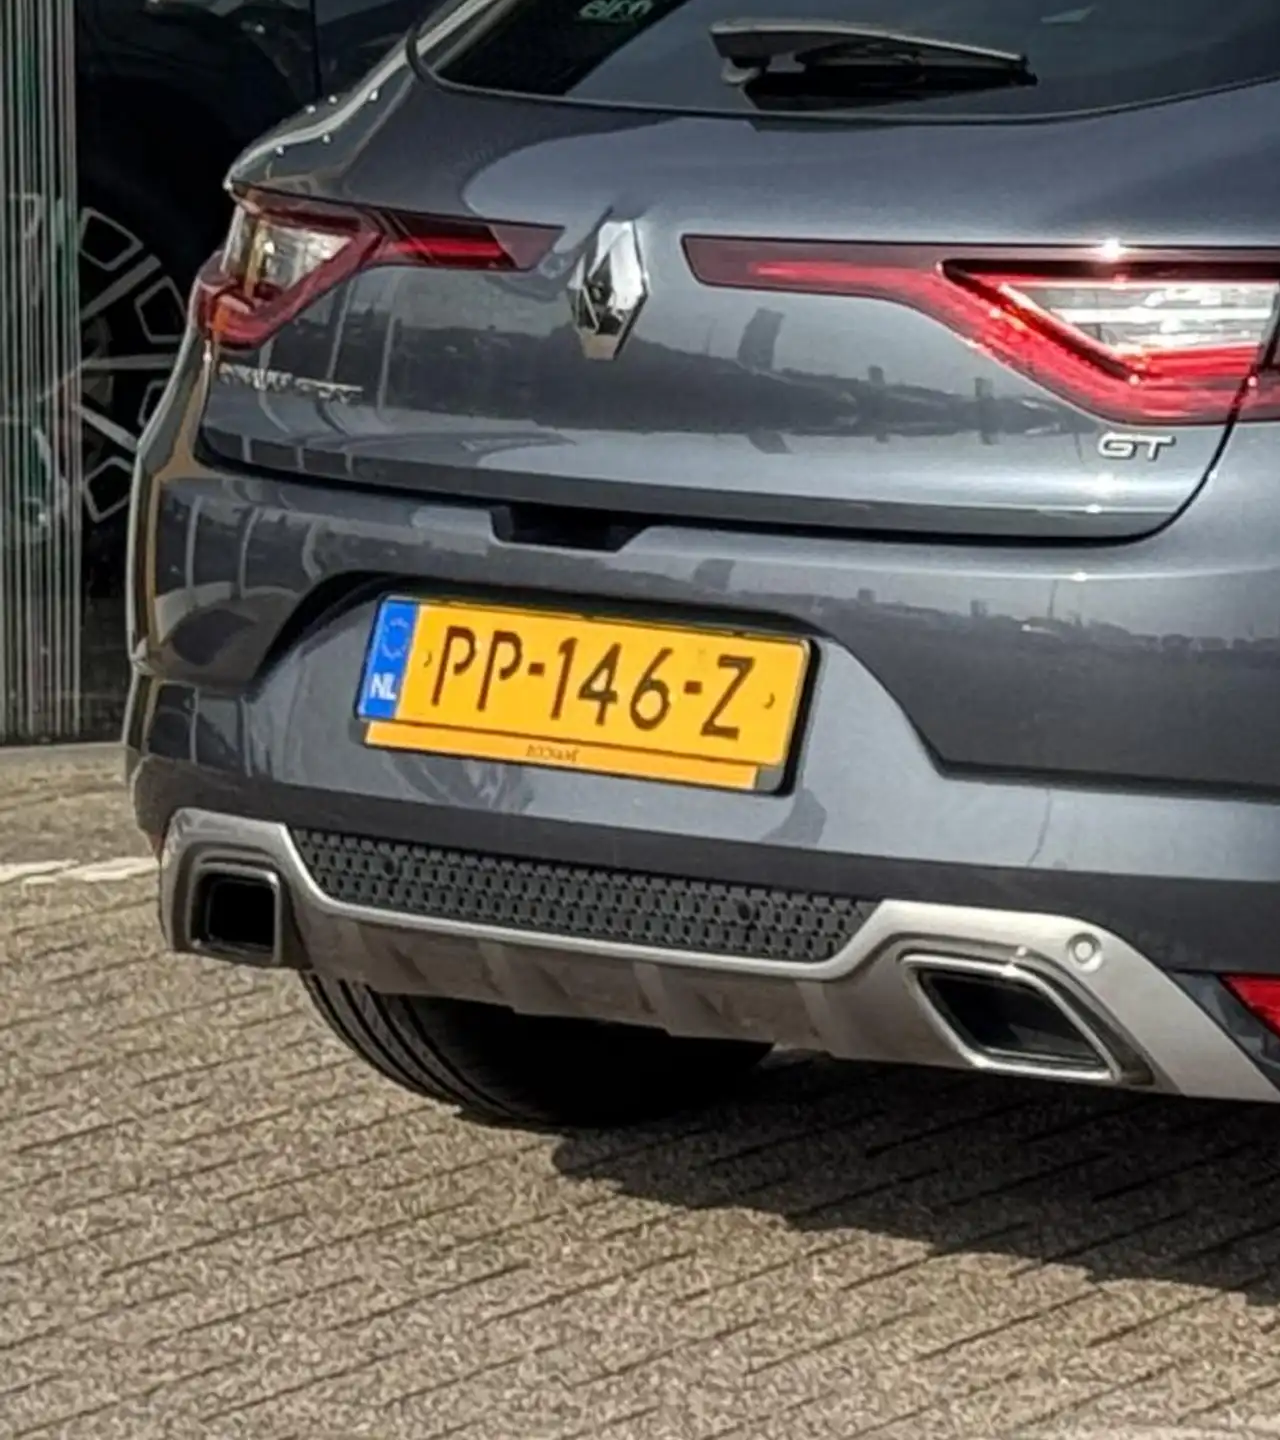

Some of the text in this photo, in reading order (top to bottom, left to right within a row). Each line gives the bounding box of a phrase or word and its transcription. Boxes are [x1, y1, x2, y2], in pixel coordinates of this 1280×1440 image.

[1098, 431, 1176, 461] GT
[369, 672, 397, 700] NL
[431, 625, 754, 740] PP-146-Z
